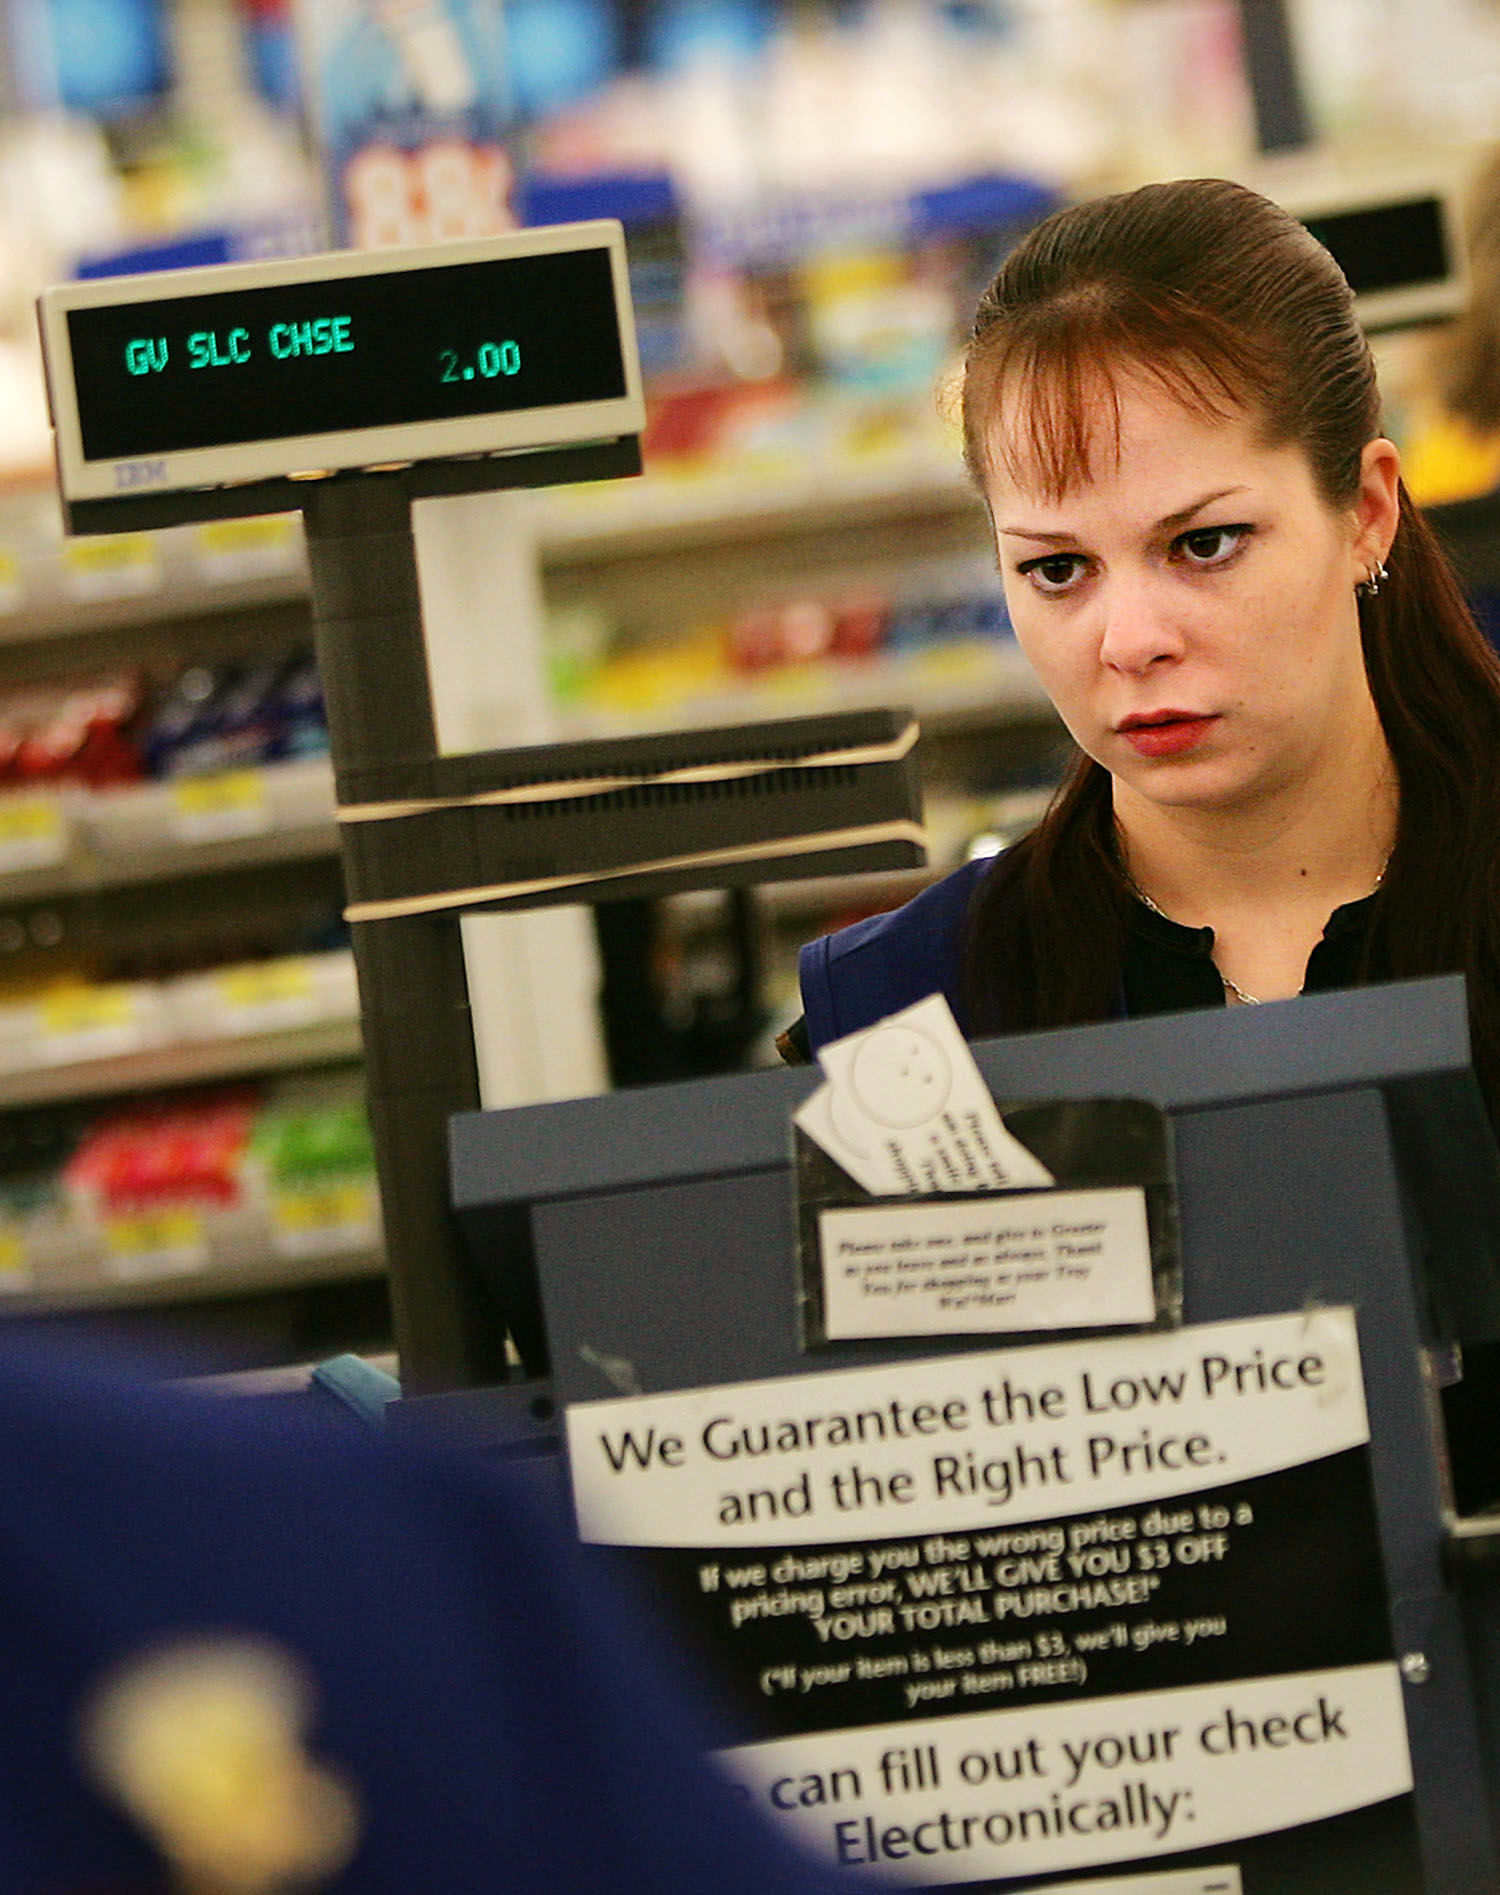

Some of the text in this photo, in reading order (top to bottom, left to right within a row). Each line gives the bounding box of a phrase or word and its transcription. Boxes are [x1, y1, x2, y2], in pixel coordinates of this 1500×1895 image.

[125, 315, 355, 376] GV SLC CHSE
[437, 339, 521, 384] 2.00
[113, 460, 168, 489] IBM
[598, 1348, 1326, 1476] We Guarantee the Low Price
[717, 1428, 1229, 1526] and the Right Price.
[699, 1501, 1255, 1594] If we charge you the wrong price due to a
[730, 1531, 1230, 1630] pricing error, WE'LL GIVE YOU $3 OFF
[799, 1661, 852, 1694] your
[855, 1653, 910, 1681] item
[910, 1650, 933, 1674] is
[932, 1644, 977, 1670] less
[976, 1638, 1034, 1666] than
[1033, 1628, 1072, 1659] $3,
[1073, 1620, 1130, 1653] we'll
[1131, 1618, 1182, 1653] give
[1182, 1614, 1229, 1647] you
[814, 1606, 896, 1644] YOUR
[898, 1594, 993, 1633] TOTAL
[904, 1675, 959, 1710] your
[959, 1668, 1016, 1697] item
[768, 1695, 1350, 1812] can fill out your check
[833, 1781, 1198, 1867] Electronically:
